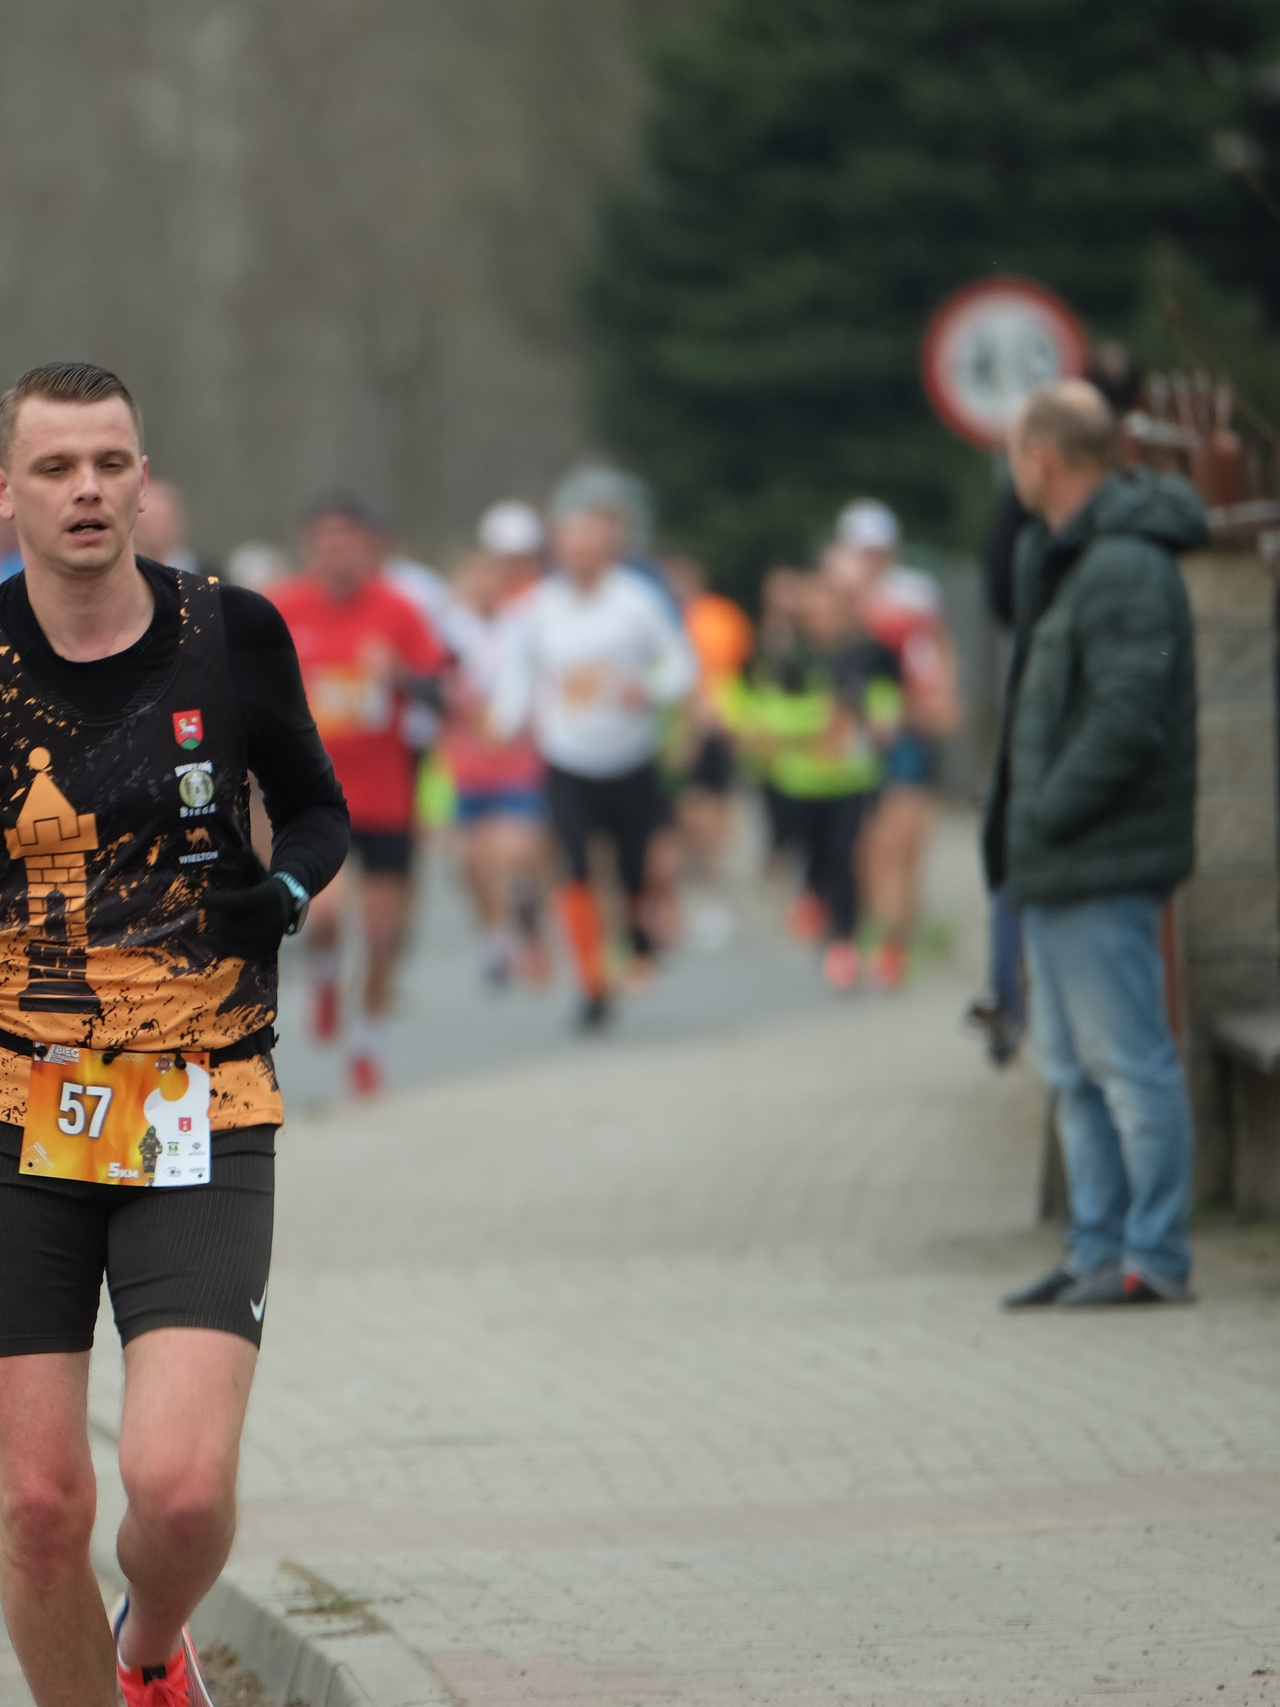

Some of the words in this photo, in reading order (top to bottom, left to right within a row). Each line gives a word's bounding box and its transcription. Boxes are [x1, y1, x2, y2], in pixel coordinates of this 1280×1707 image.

[179, 850, 219, 864] WIELTON
[55, 1045, 79, 1058] BIEG
[57, 1081, 113, 1139] 57
